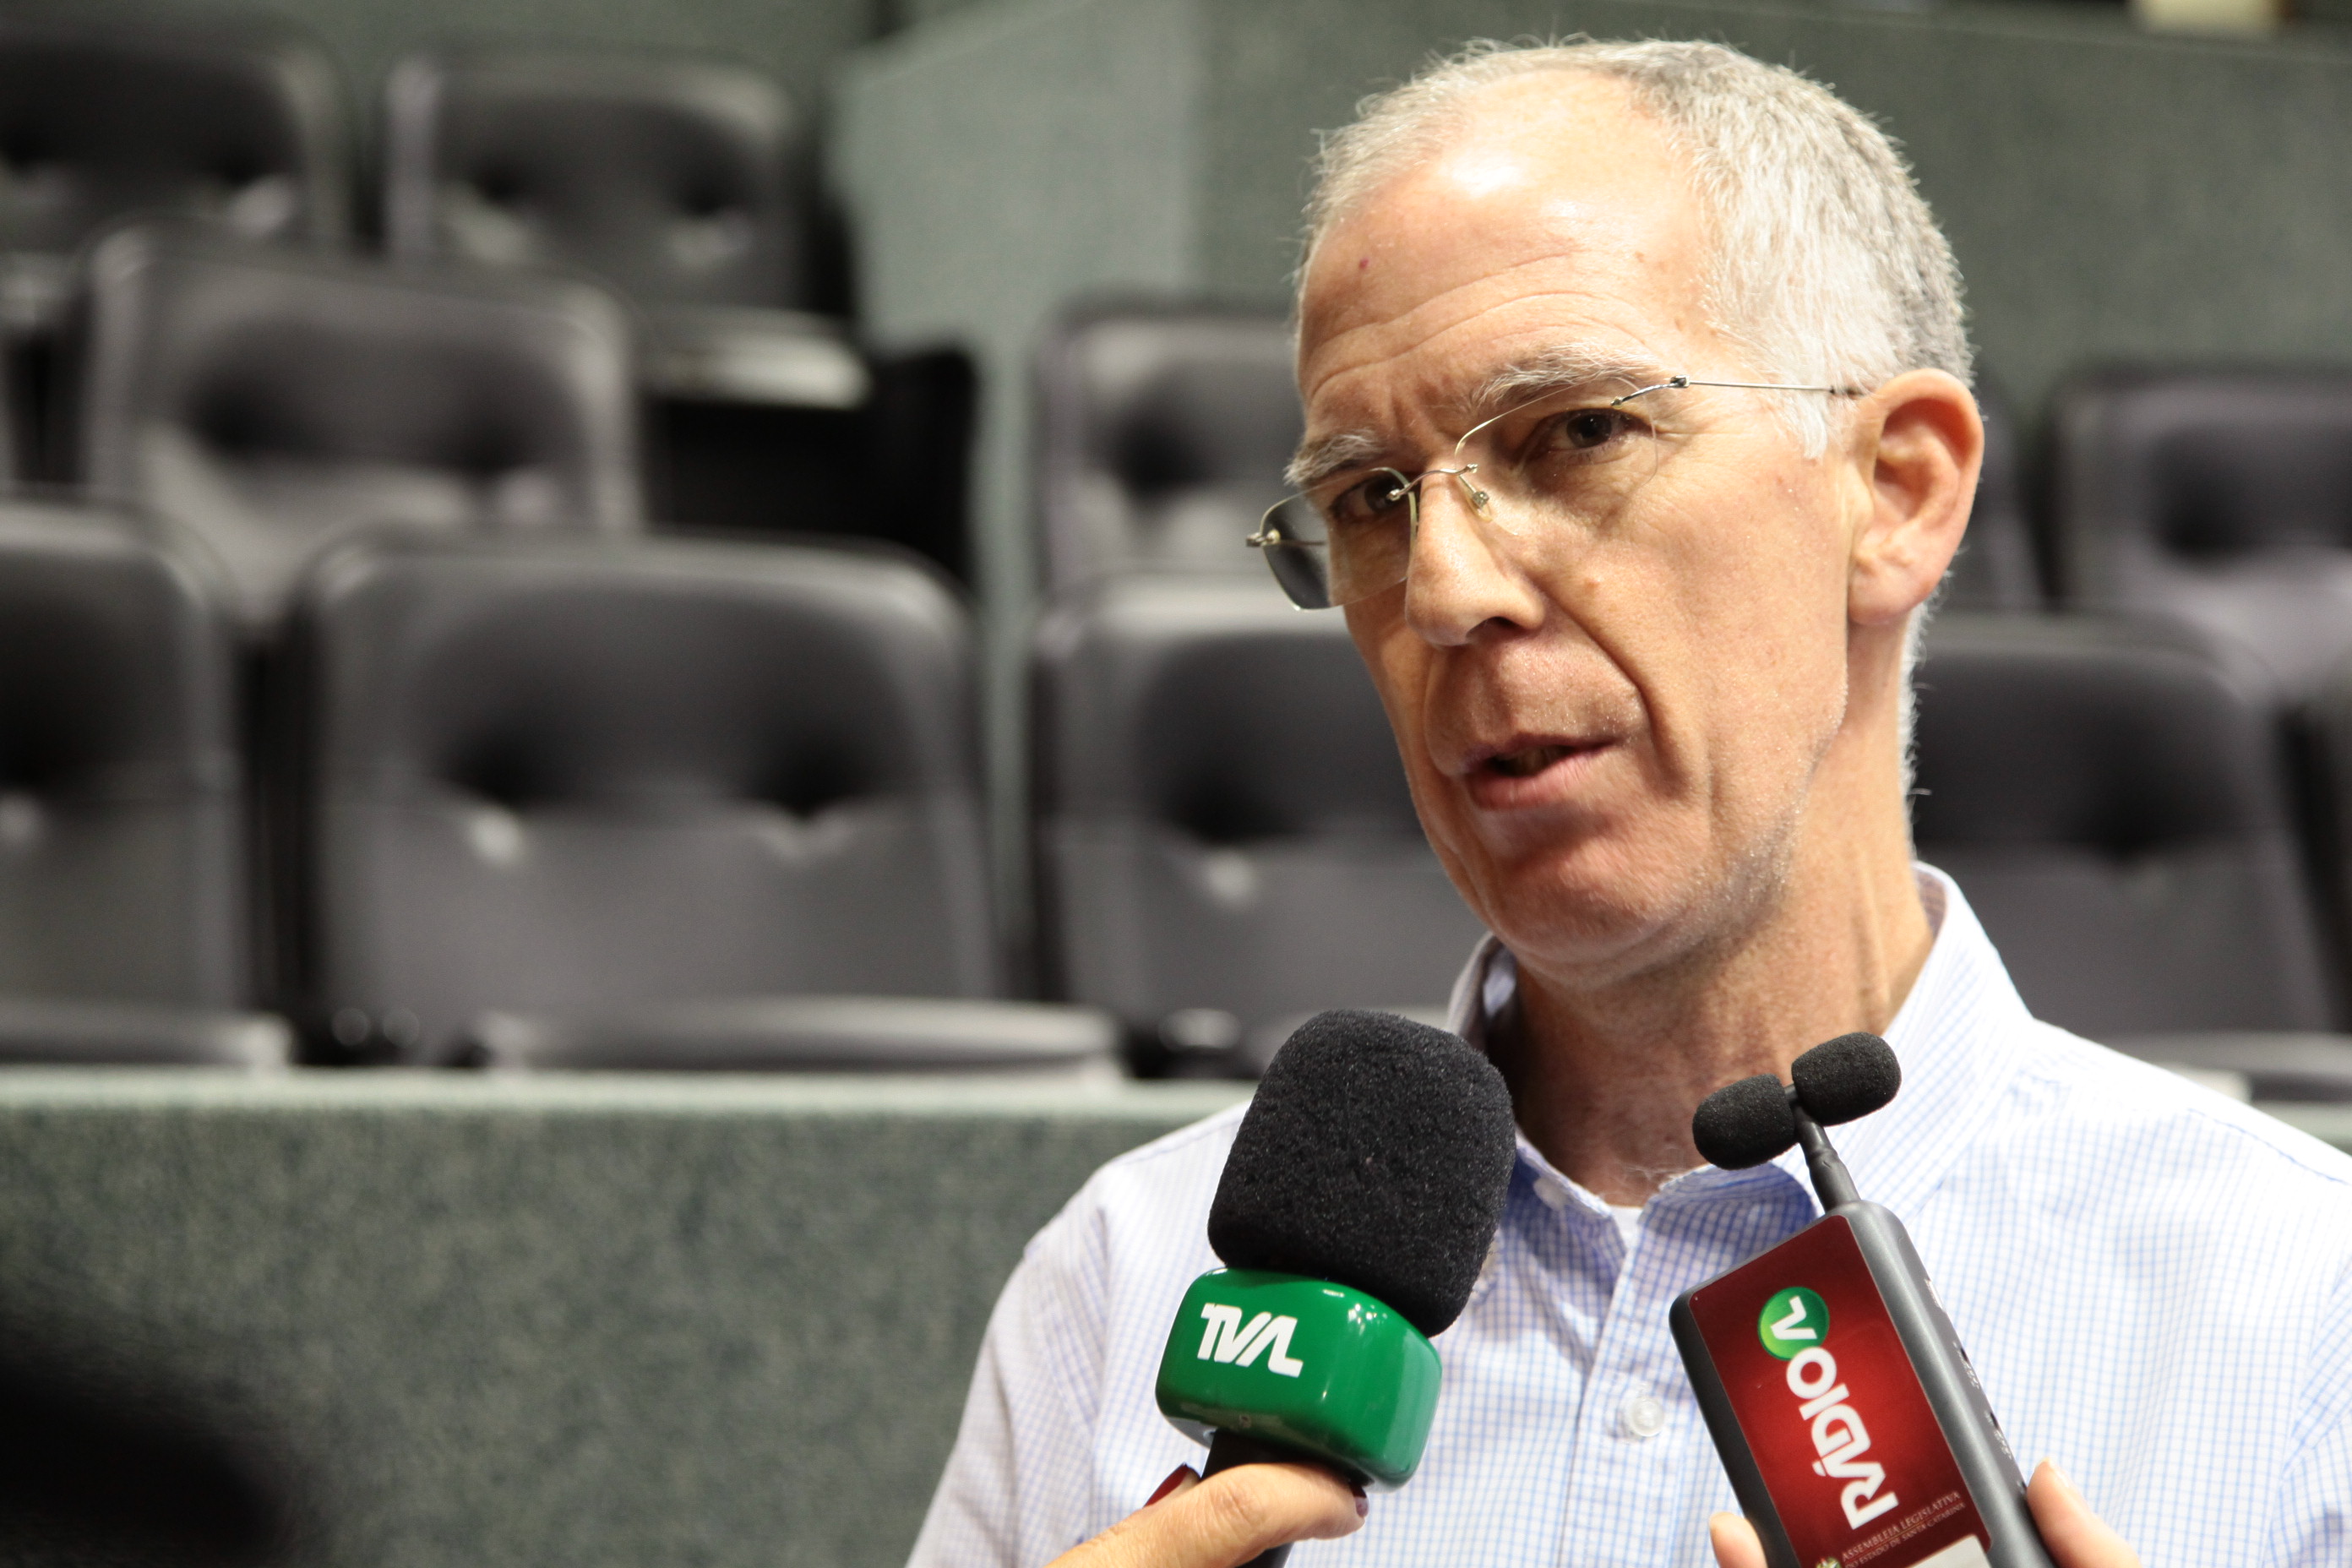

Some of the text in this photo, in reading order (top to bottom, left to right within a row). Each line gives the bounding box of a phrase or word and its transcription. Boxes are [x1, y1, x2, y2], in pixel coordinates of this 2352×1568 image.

[1197, 1303, 1304, 1378] TVAL
[1786, 1347, 1899, 1530] RÁDIO
[1900, 1491, 1960, 1528] LEGISLATIVA
